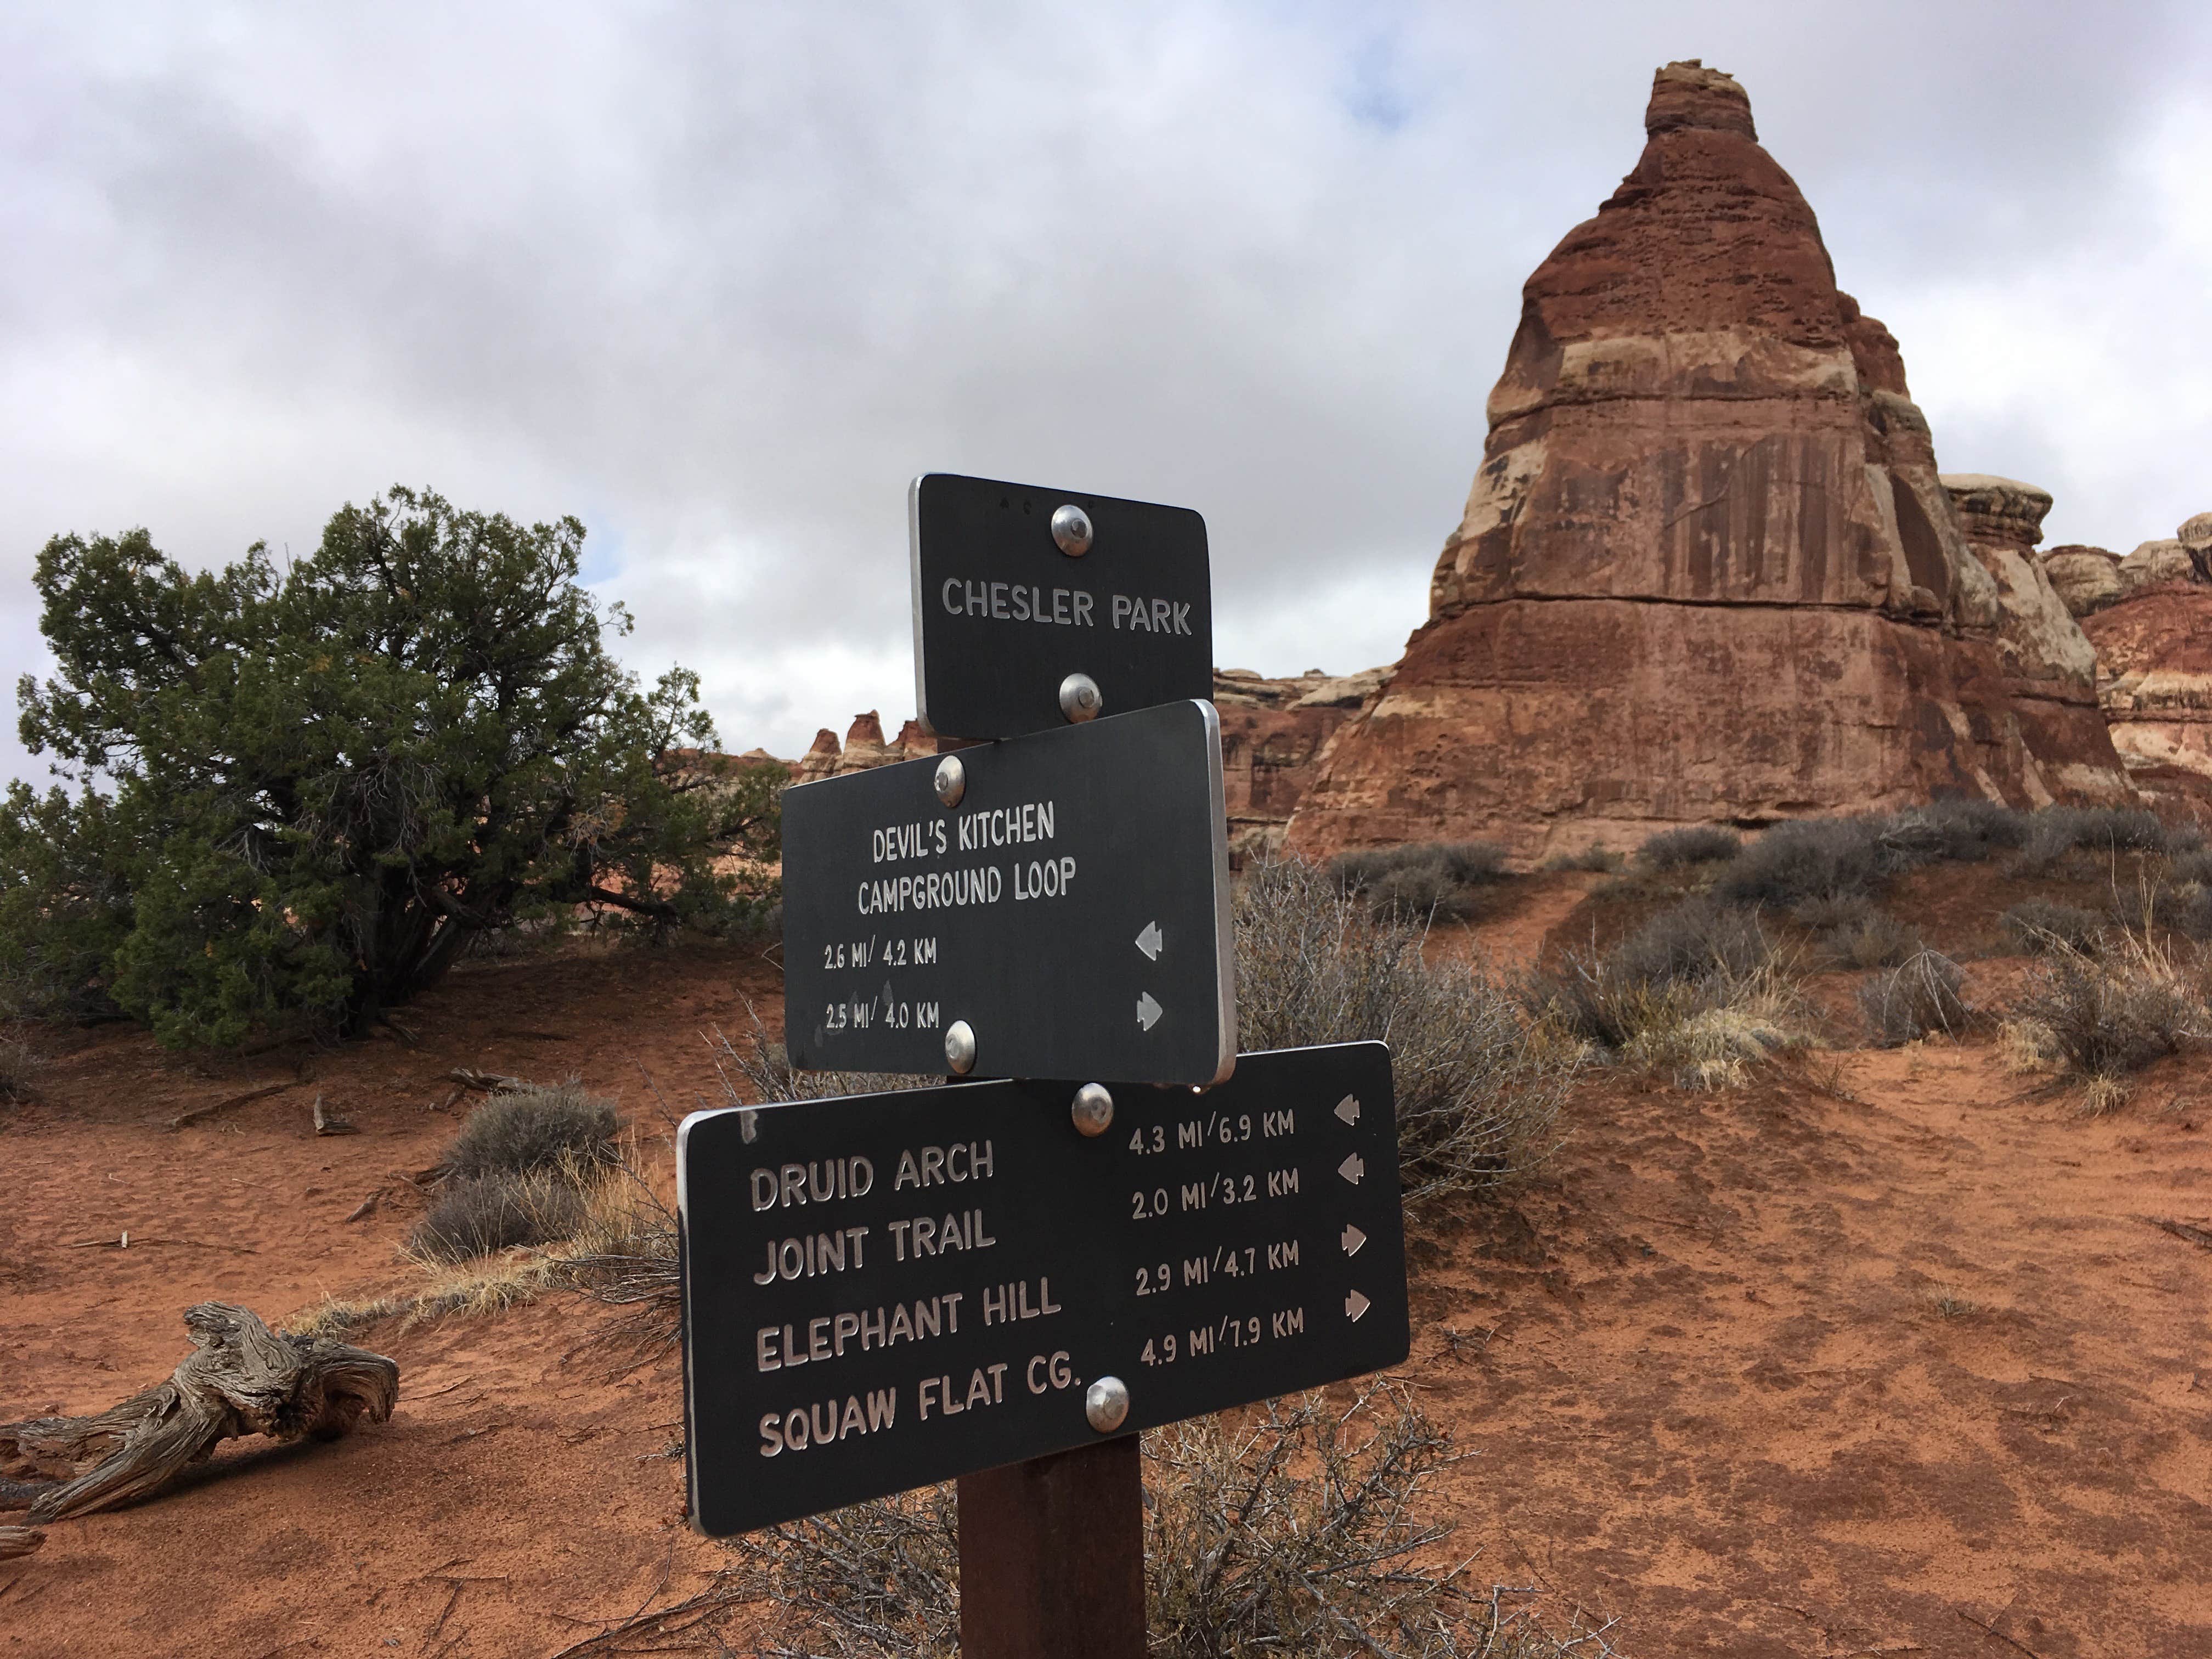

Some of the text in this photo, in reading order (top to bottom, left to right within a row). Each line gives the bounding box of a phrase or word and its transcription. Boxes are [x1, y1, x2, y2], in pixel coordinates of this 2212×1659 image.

[942, 578, 1192, 636] CHESLER PARK
[873, 800, 1054, 863] DEVIL'S KITCHEN
[858, 856, 1076, 915] CAMPGROUND LOOP
[825, 934, 936, 969] 2.6 MI/ 4.2 KM
[826, 996, 939, 1029] 2.5 MI/ 4.0 KM
[1129, 1108, 1294, 1155] 4.3 MI/6.9 KM
[750, 1139, 994, 1212] DRUID ARCH
[1132, 1167, 1299, 1220] 2.0 MI/3.2 KM
[753, 1209, 996, 1285] JOINT TRAIL
[1136, 1239, 1299, 1296] 2.9 MI/4.7 KM
[757, 1277, 1062, 1373] ELEPHANT HILL
[1141, 1307, 1304, 1367] 4.9 MI/7.9 KM
[759, 1351, 1081, 1458] SQUAW FLAT CG.
